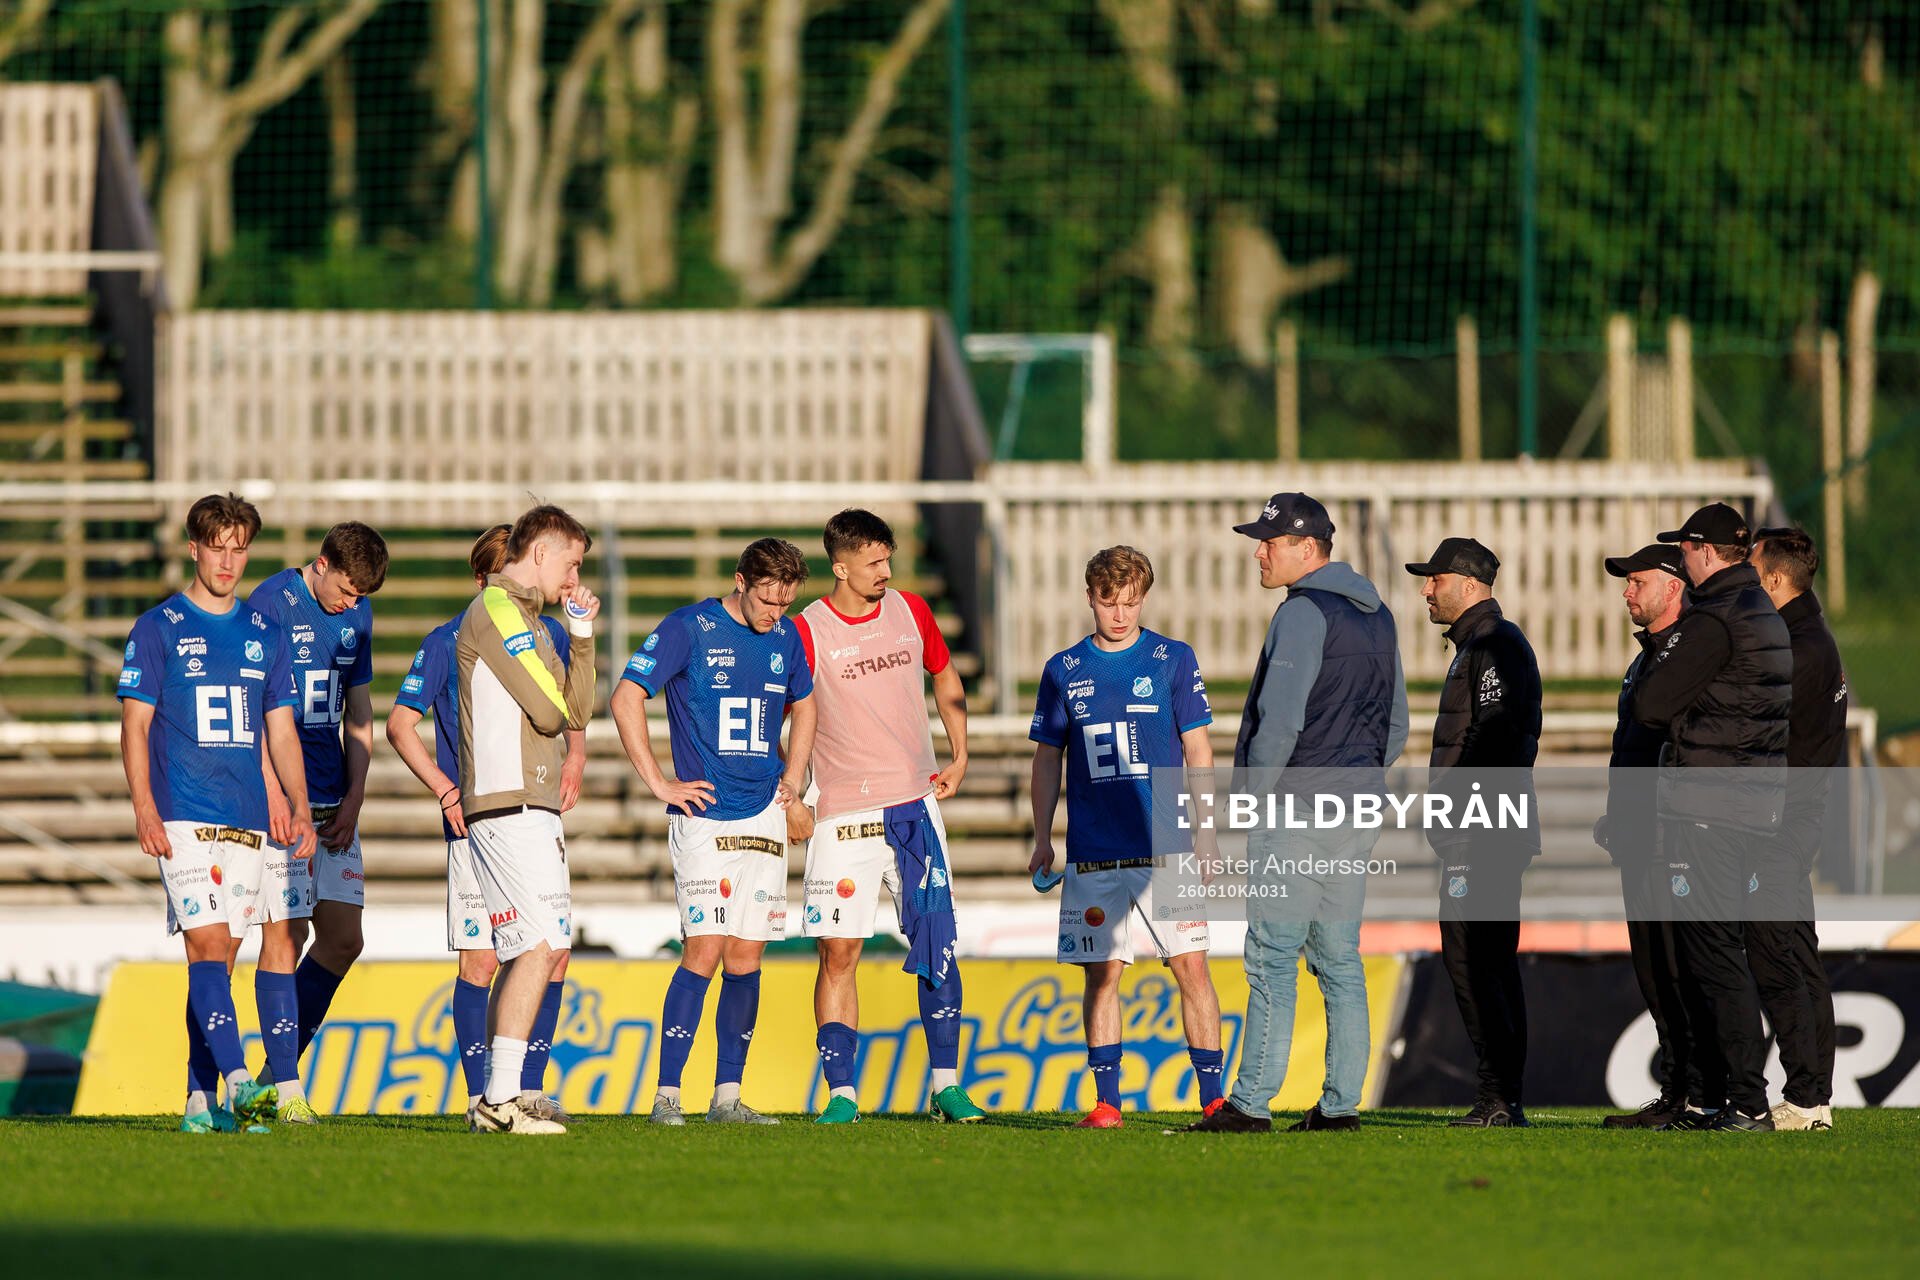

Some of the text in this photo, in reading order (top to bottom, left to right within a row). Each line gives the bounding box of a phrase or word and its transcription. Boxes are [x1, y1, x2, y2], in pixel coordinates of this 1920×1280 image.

[195, 685, 255, 744] EL
[760, 698, 768, 740] PROJEKT.
[718, 697, 769, 753] EL
[1082, 721, 1149, 779] EL
[1129, 720, 1139, 762] PROJEKT.
[717, 838, 735, 850] XL
[167, 867, 207, 881] Sparbanken
[265, 861, 306, 870] Sparbanken
[208, 893, 217, 911] 6
[714, 906, 725, 924] 18
[832, 908, 840, 924] 4
[1081, 936, 1094, 953] 11
[1001, 975, 1187, 1051] Geås
